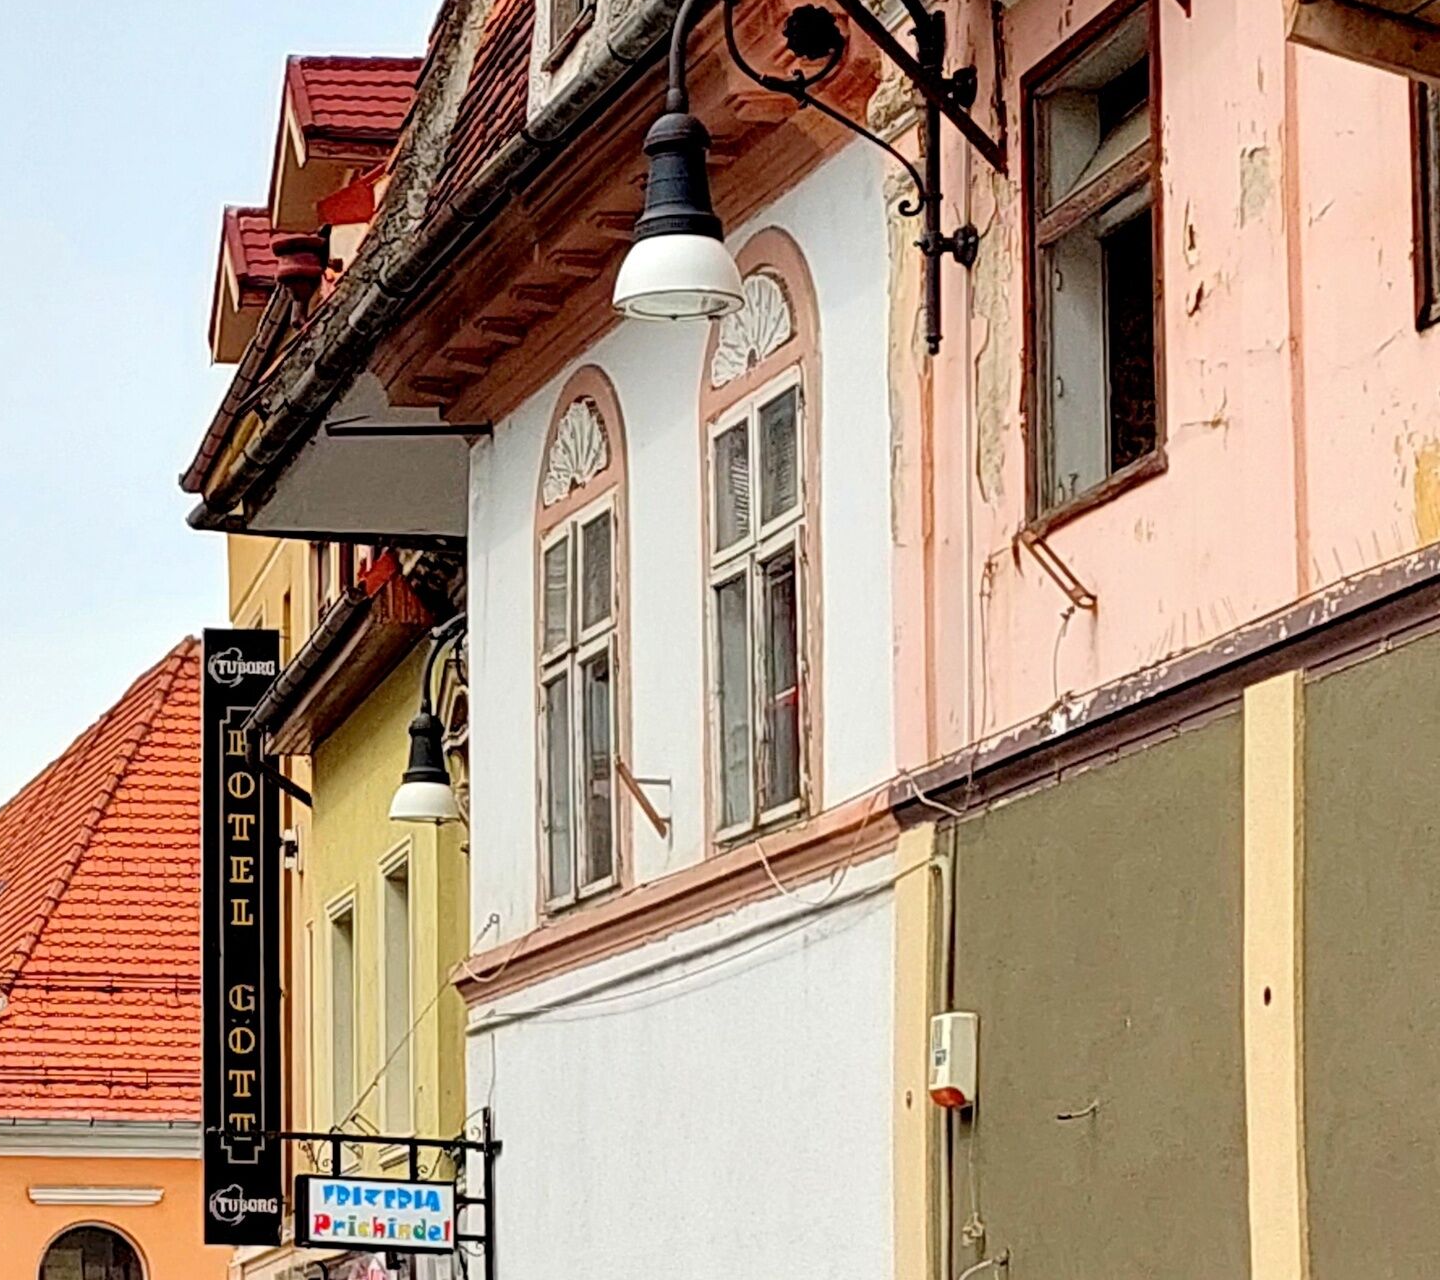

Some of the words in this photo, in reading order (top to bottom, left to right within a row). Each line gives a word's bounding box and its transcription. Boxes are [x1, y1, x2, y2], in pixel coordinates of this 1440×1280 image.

[216, 659, 276, 677] TUBORG
[226, 730, 256, 926] HOTEL
[217, 1197, 278, 1214] TUBORG
[313, 1214, 451, 1242] Prichindel
